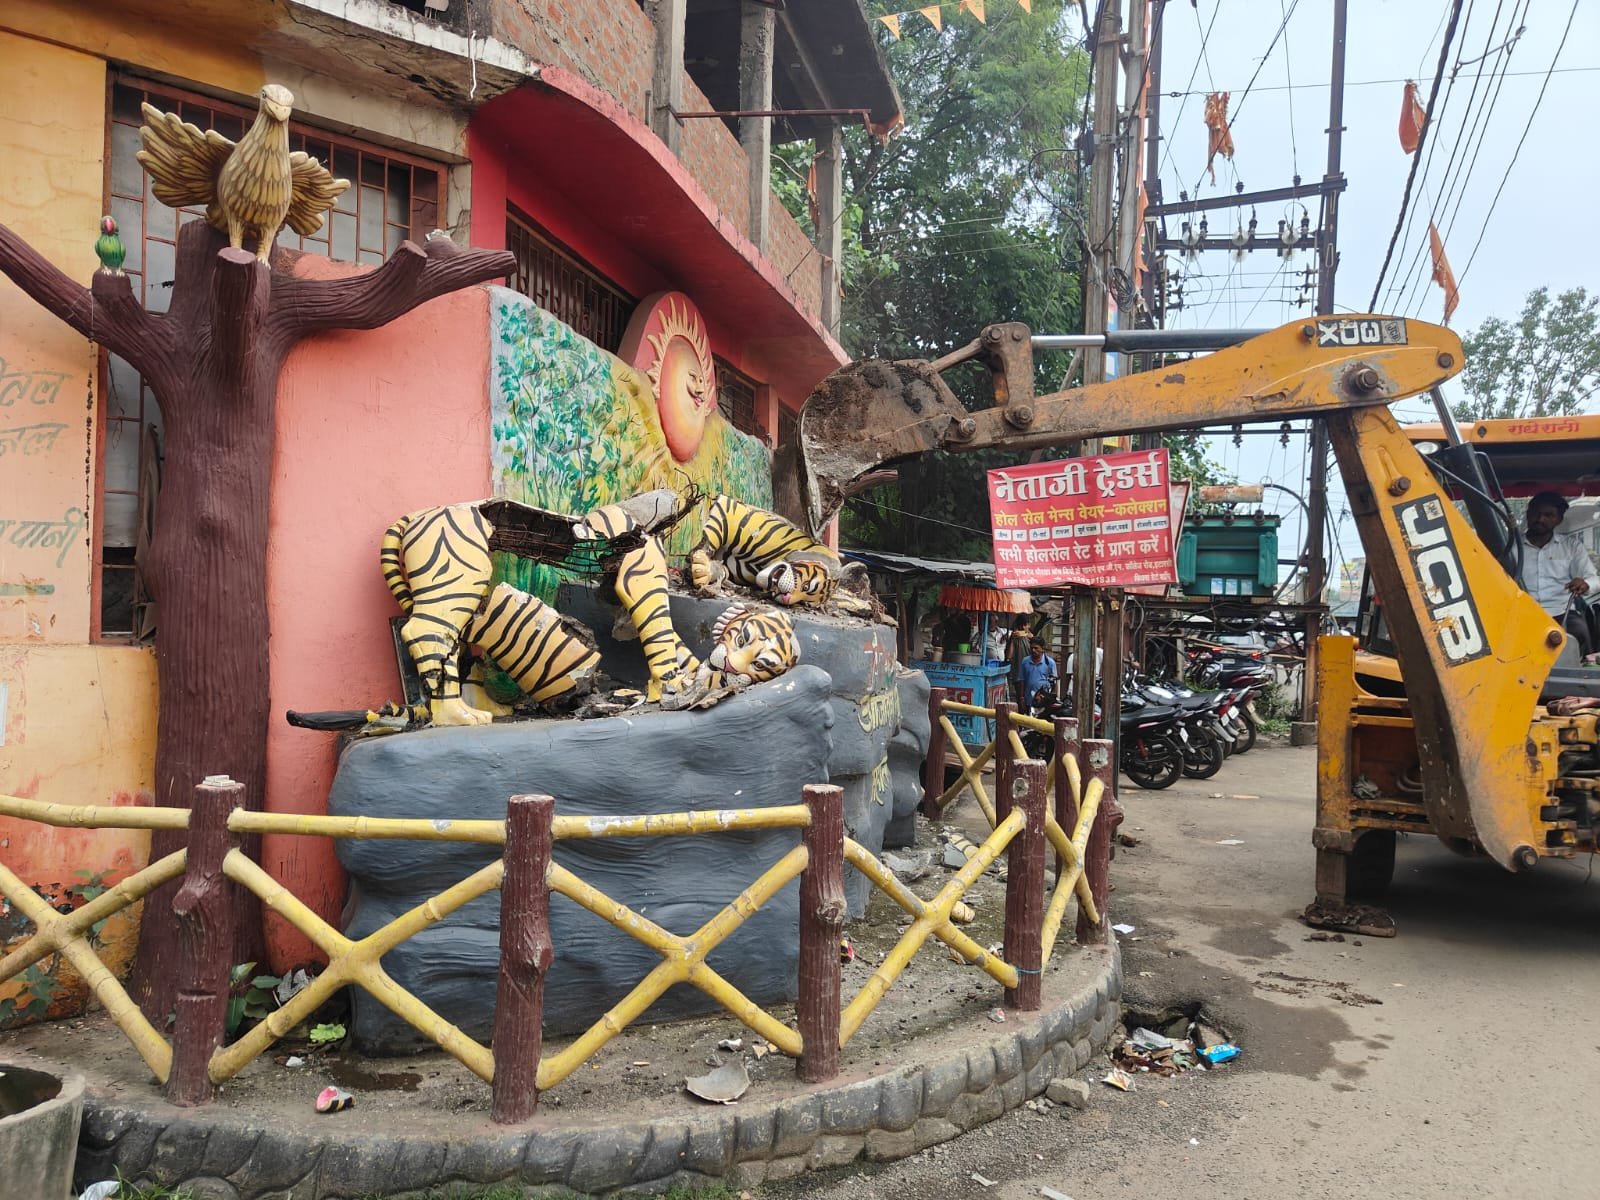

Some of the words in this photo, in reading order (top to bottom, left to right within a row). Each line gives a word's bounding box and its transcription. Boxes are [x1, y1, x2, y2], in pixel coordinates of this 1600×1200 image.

[993, 462, 1088, 503] नेताजी
[1093, 451, 1162, 498] ट्रेडर्स
[994, 511, 1018, 527] होल
[1021, 508, 1044, 524] सेल
[1048, 505, 1074, 522] मेन्स
[998, 544, 1022, 562] सभी
[1024, 543, 1070, 564] होलसेल
[1073, 540, 1091, 559] रेट
[1093, 538, 1105, 558] में
[1108, 538, 1135, 557] प्राप्त
[1138, 534, 1159, 554] करें
[1401, 503, 1483, 660] JCB
